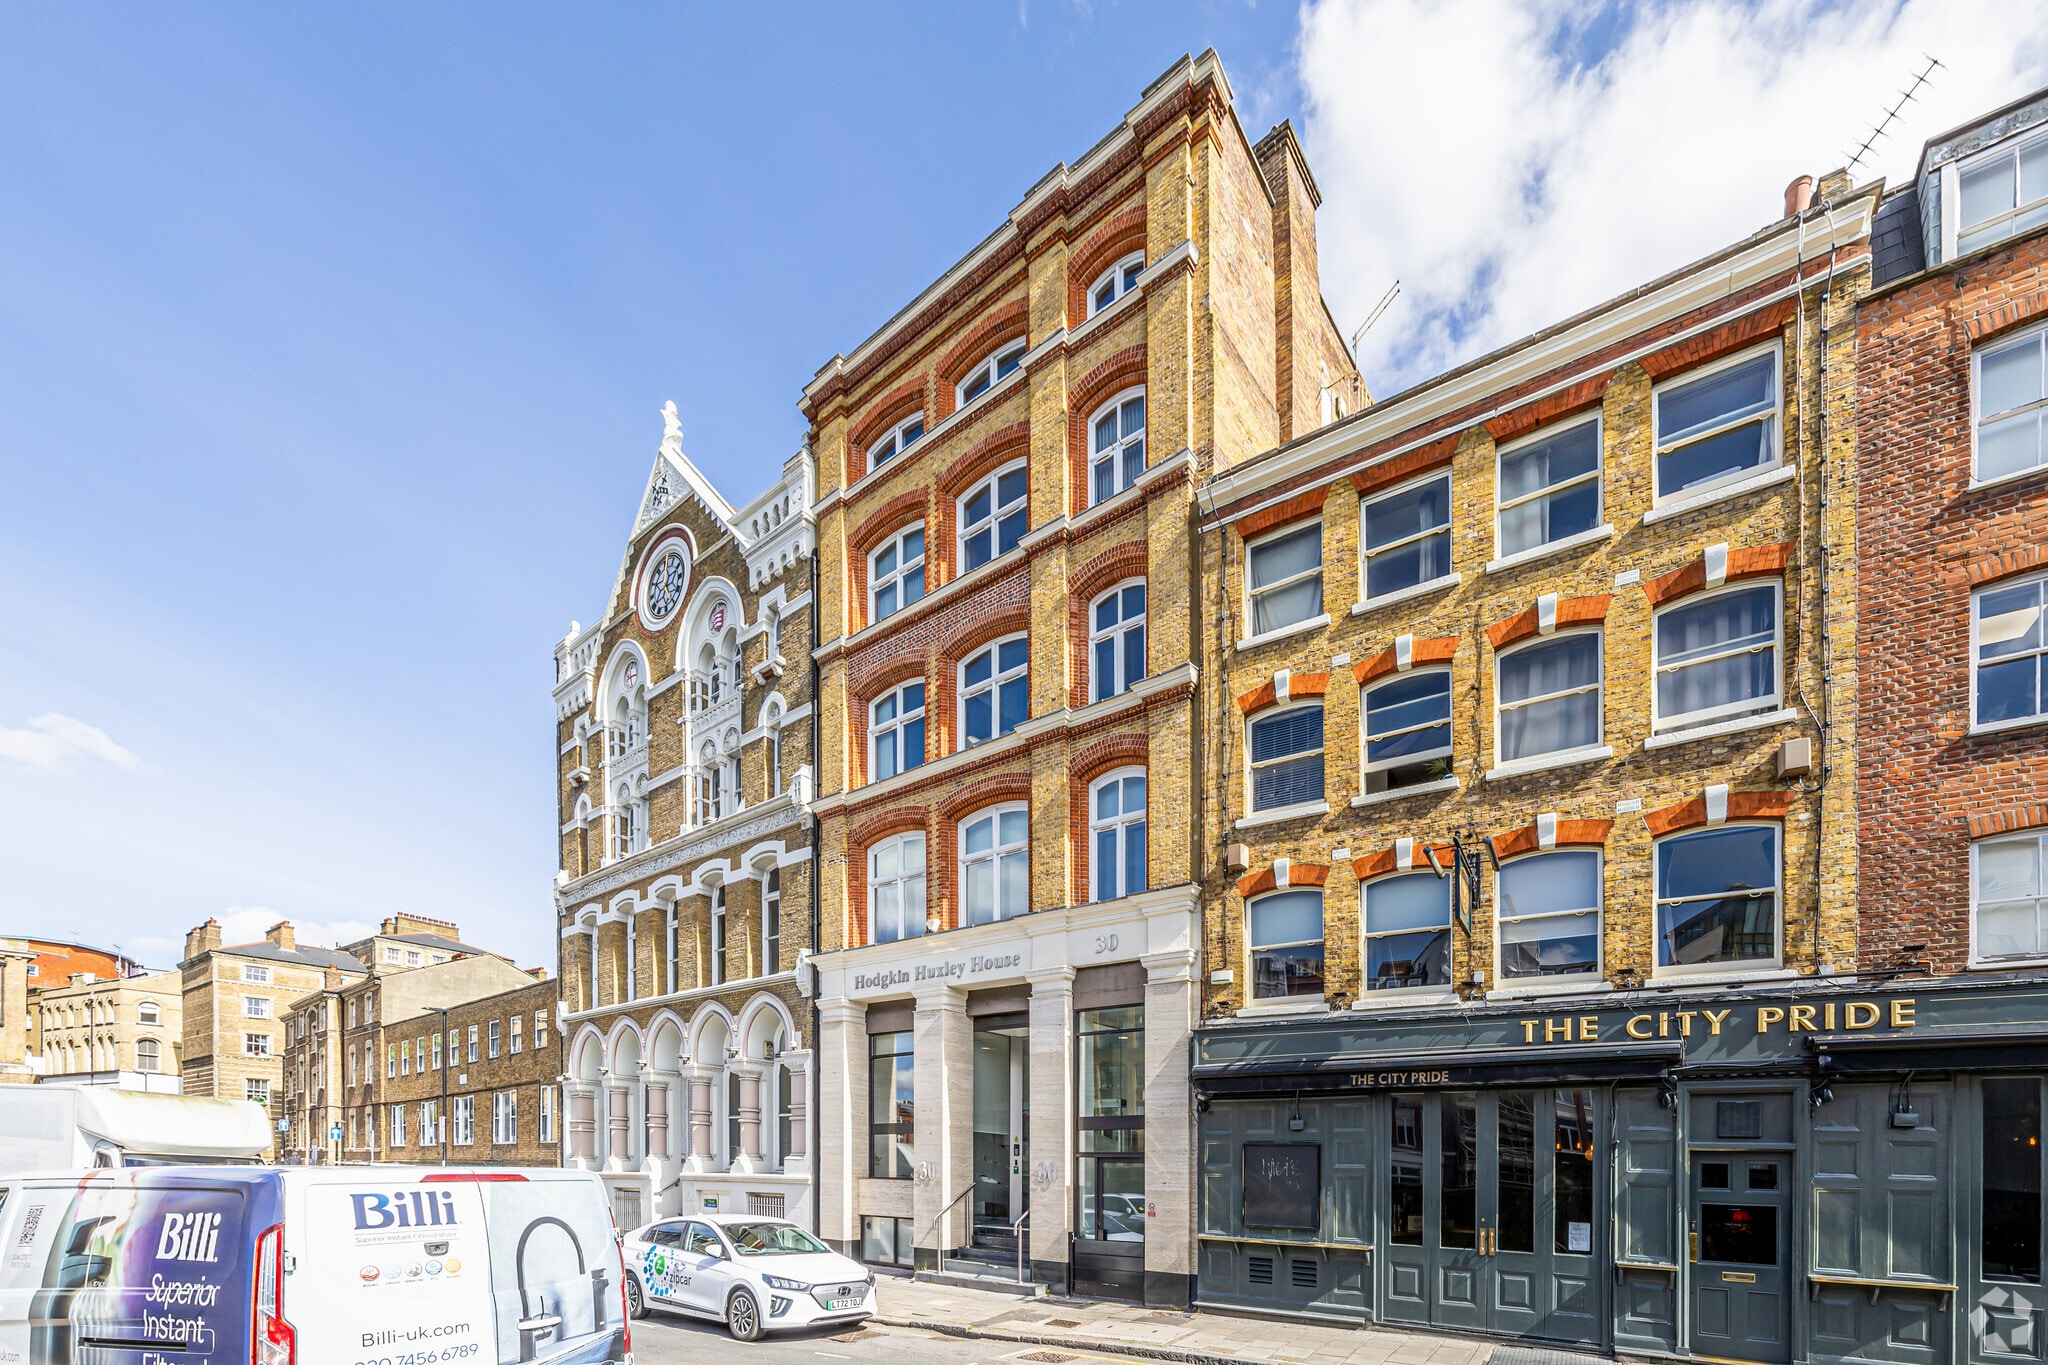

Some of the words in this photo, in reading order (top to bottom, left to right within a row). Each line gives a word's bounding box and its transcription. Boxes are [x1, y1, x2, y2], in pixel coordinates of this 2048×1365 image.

[1095, 934, 1119, 954] 30
[854, 970, 910, 990] Hodgkin
[914, 960, 966, 980] Huxley
[970, 953, 1021, 973] House
[1520, 1015, 1599, 1044] THE
[1626, 1009, 1732, 1040] CITY
[1757, 998, 1917, 1034] PRIDE
[1350, 1074, 1375, 1086] THE
[1379, 1072, 1408, 1085] CITY
[1411, 1070, 1449, 1083] PRIDE
[919, 1160, 937, 1180] 30
[1037, 1160, 1059, 1183] 30
[349, 1191, 458, 1230] Billi
[355, 1236, 386, 1244] Superior
[145, 1273, 221, 1310] Superior
[669, 1273, 692, 1287] zipcar
[143, 1308, 205, 1344] Instant
[362, 1323, 470, 1348] Billi-uk.com
[395, 1350, 438, 1365] 7456
[441, 1343, 479, 1361] 6789
